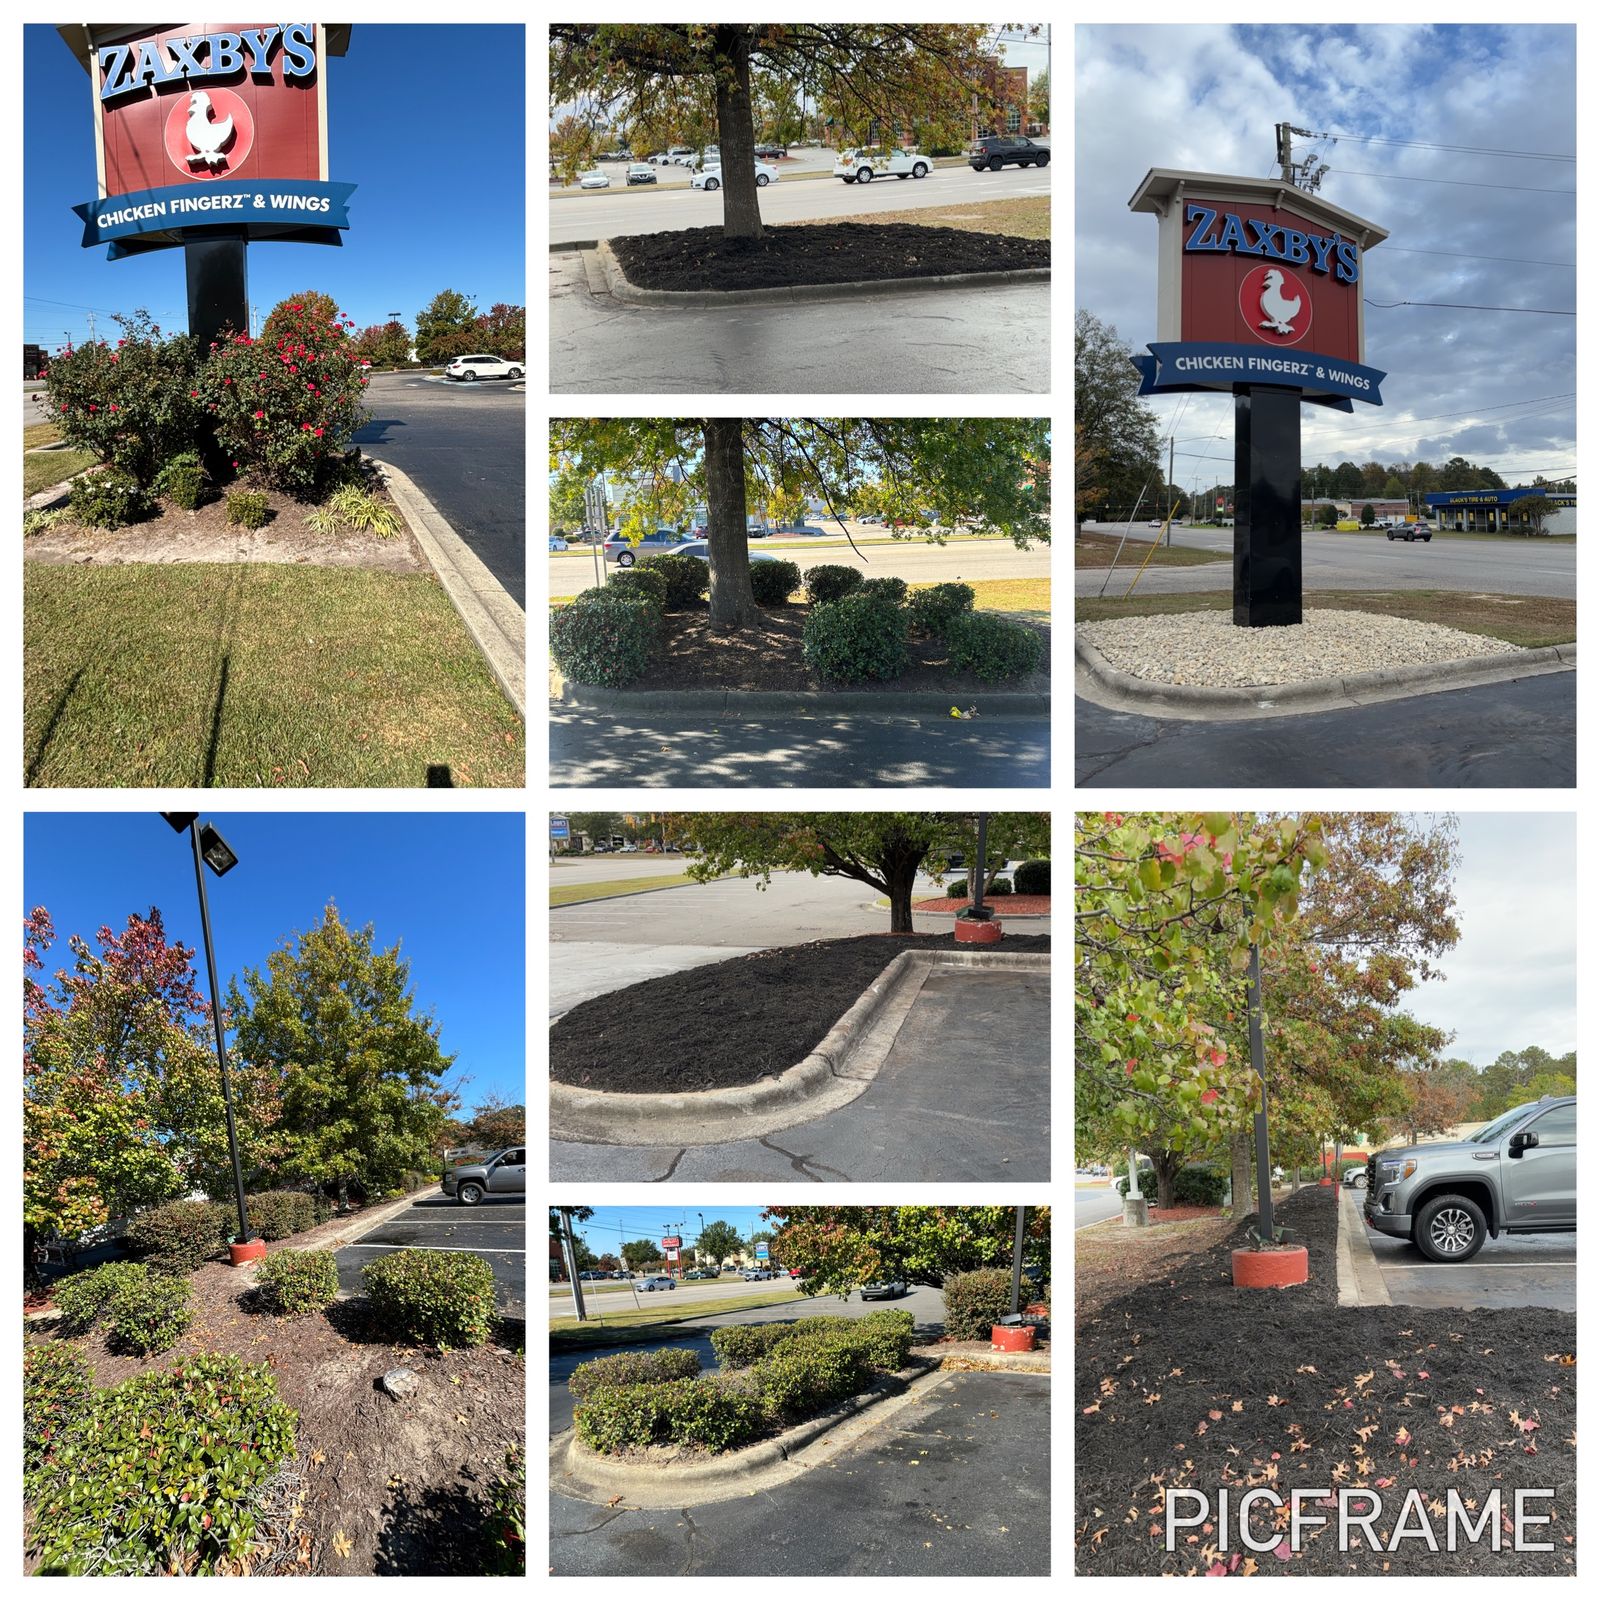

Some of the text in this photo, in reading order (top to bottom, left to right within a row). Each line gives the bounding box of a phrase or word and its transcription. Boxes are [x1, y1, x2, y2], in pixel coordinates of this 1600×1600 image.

[99, 23, 316, 100] ZAXBY'S
[97, 202, 166, 228] CHICKEN
[253, 195, 266, 208] &
[270, 194, 330, 212] WINGS
[1186, 204, 1360, 283] ZAXBY'S
[1175, 356, 1244, 370] CHICKEN
[1315, 366, 1325, 379] &
[1328, 368, 1370, 391] WINGS
